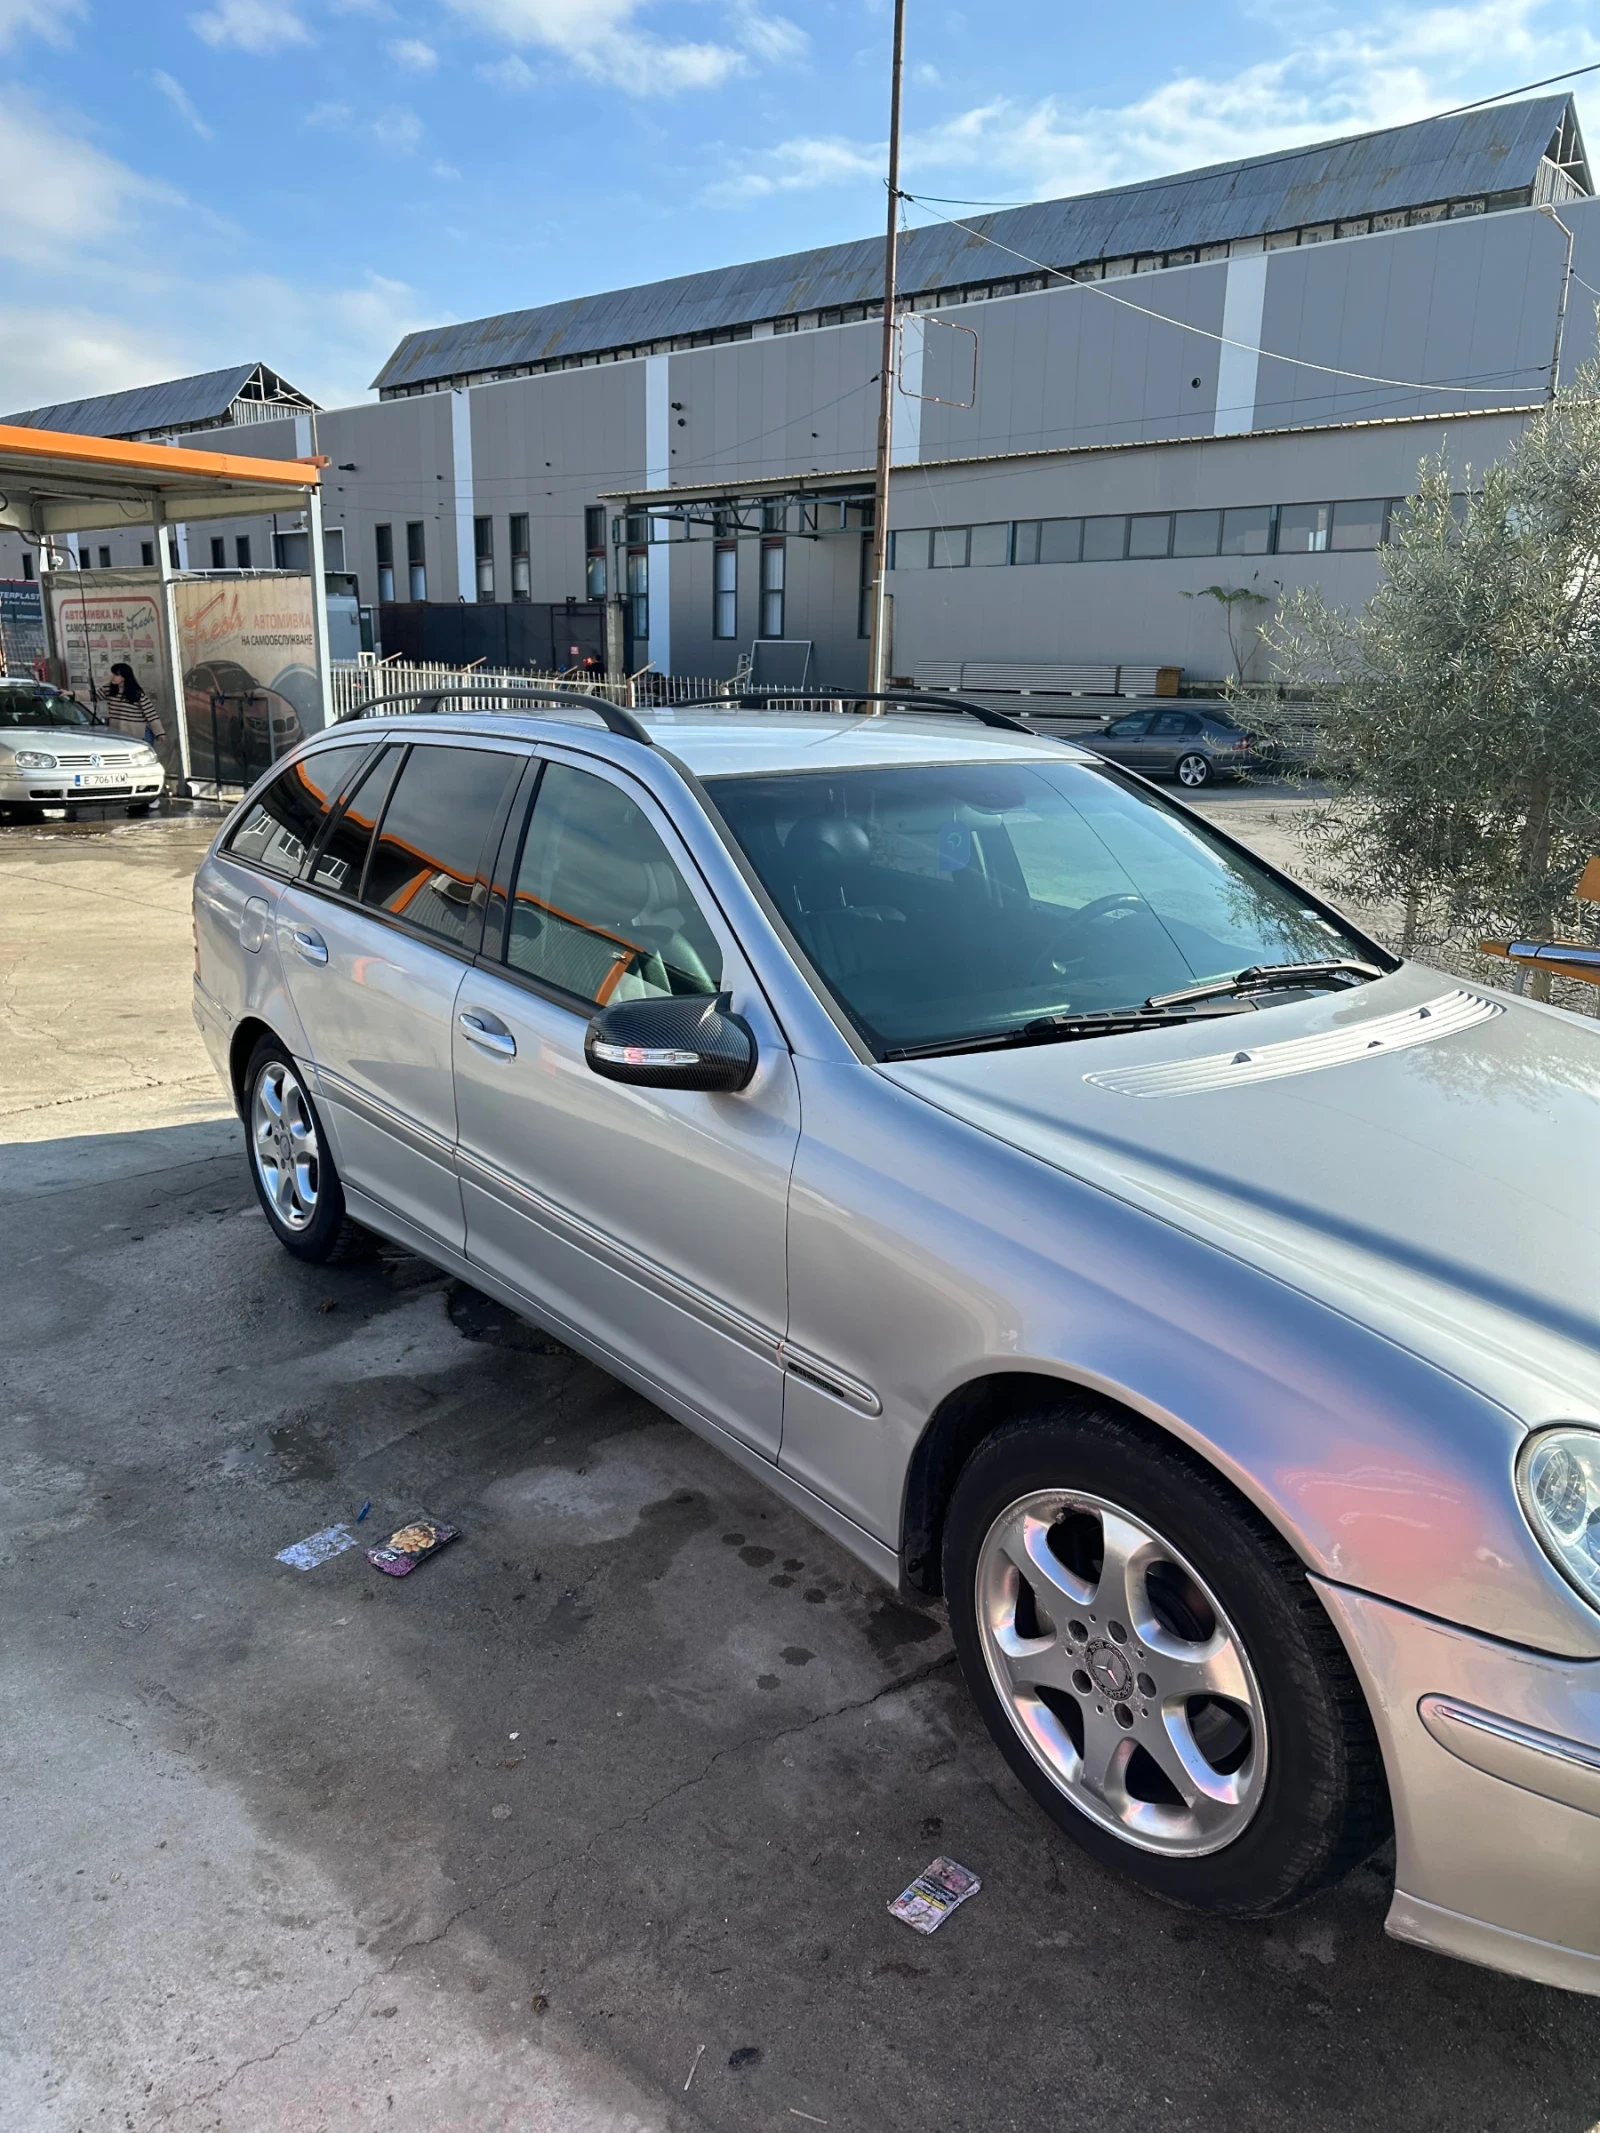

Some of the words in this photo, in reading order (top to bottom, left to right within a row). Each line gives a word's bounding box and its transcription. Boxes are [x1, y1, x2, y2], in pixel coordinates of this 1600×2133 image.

[65, 609, 110, 620] АВТОМИВКА
[112, 609, 124, 619] НА
[65, 622, 126, 632] САМООБСЛУЖВАНЕ
[254, 612, 312, 630] АВТОМИВКА
[184, 591, 246, 667] Fresh
[241, 635, 251, 646] НА
[251, 633, 313, 647] САМООБСЛУЖВАНЕ
[83, 776, 90, 785] E
